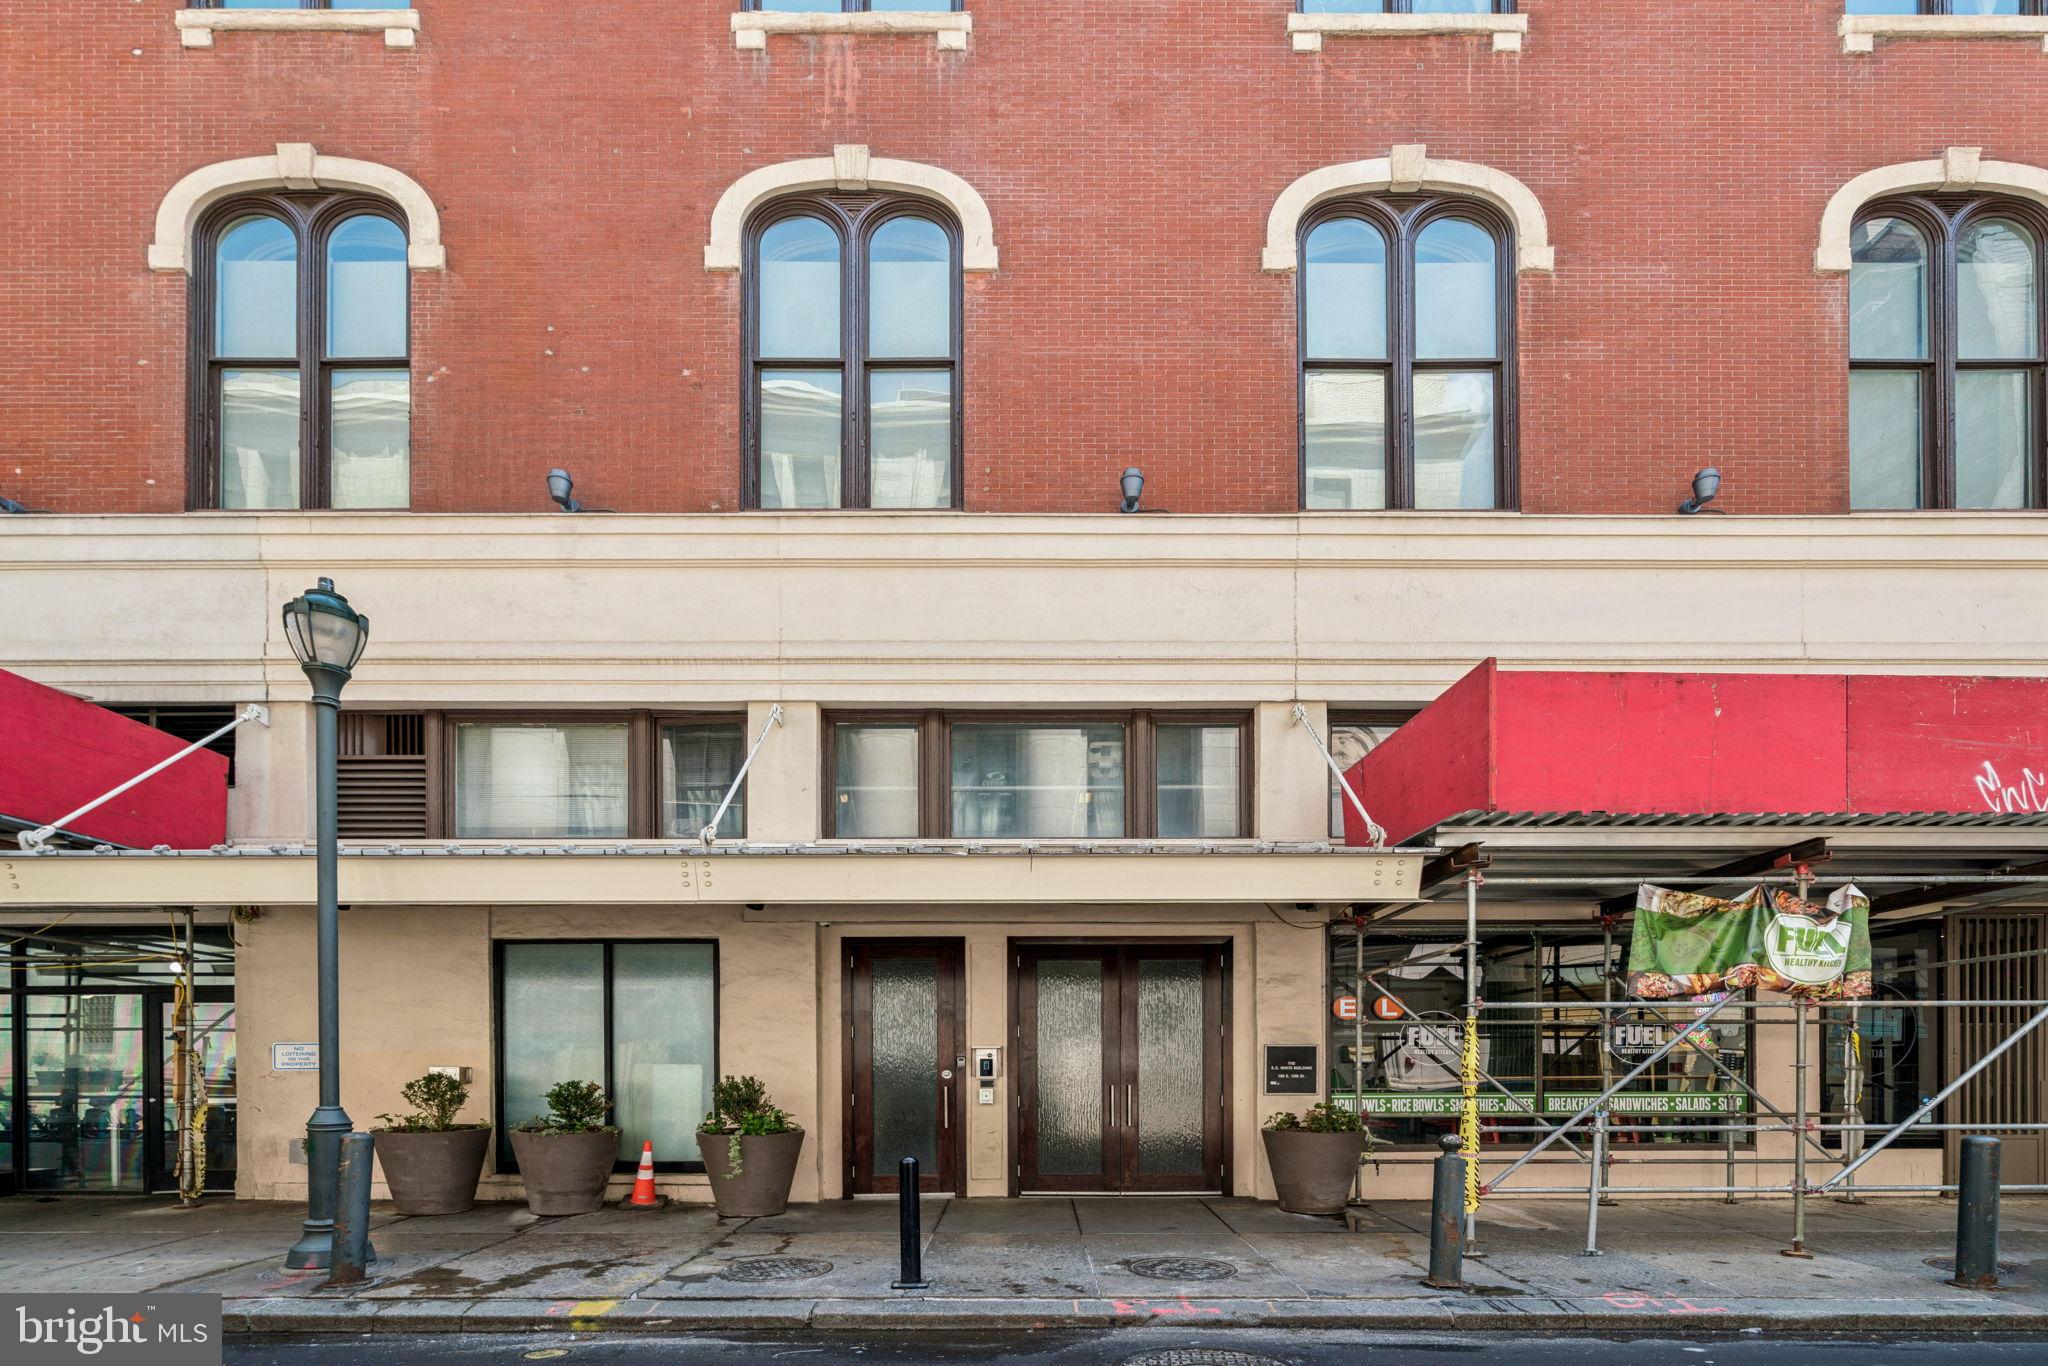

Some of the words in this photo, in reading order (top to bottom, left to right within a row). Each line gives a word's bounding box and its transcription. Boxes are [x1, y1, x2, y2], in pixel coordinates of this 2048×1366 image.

[1784, 958, 1818, 967] HEALTHY
[1408, 1026, 1459, 1047] FUEL
[1615, 1026, 1666, 1045] FUEL
[1354, 1098, 1386, 1112] OWLS
[1391, 1098, 1411, 1112] RICE
[1412, 1098, 1444, 1112] BOWLS
[1450, 1098, 1499, 1112] SMTHIES
[1548, 1097, 1600, 1111] BREAKFA
[1608, 1097, 1669, 1111] SANDWICHES
[1675, 1097, 1711, 1111] SALADS
[1718, 1097, 1742, 1111] SOP
